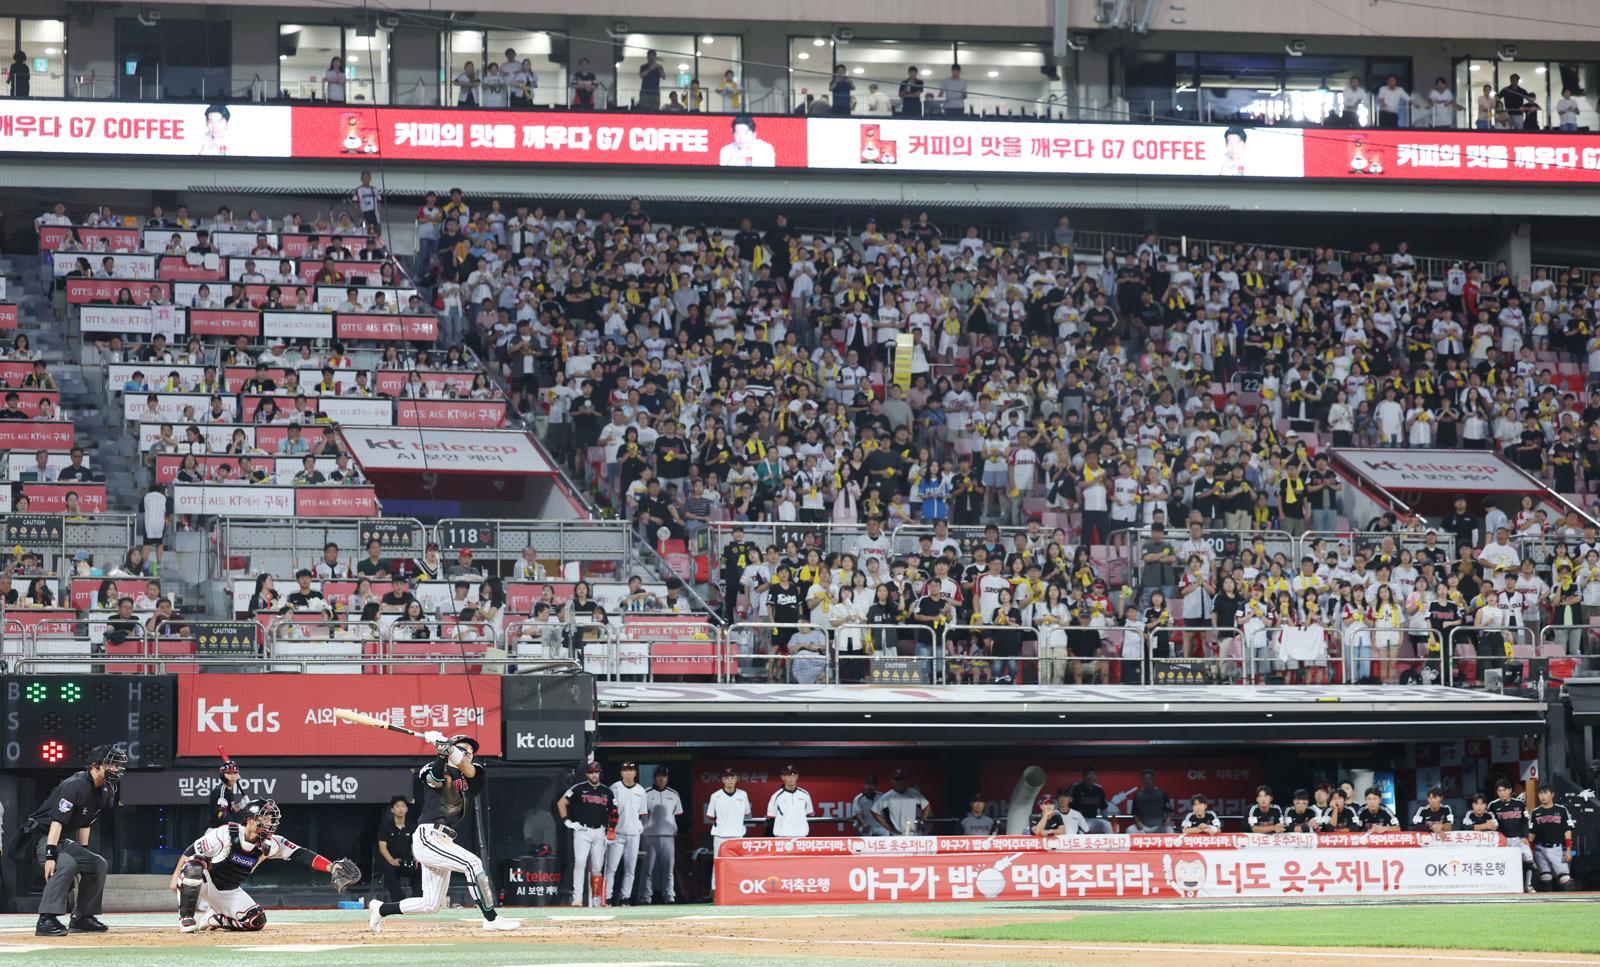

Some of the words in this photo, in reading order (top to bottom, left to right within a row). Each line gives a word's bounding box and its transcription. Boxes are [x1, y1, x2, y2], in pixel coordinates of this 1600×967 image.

[70, 116, 95, 138] G7
[104, 117, 184, 140] COFFEE
[394, 122, 463, 147] 커피의
[470, 124, 515, 148] 맛을
[522, 125, 591, 151] 깨우다
[596, 127, 623, 151] G7
[629, 128, 708, 153] COFFEE
[908, 135, 973, 157] 커피의
[981, 136, 1022, 158] 맛을
[1030, 137, 1095, 159] 깨우다
[1102, 139, 1125, 160] G7
[1133, 140, 1206, 161] COFFEE
[1397, 144, 1461, 168] 커피의
[1466, 145, 1508, 169] 맛을
[1513, 146, 1579, 170] 깨우다
[1244, 379, 1259, 391] 22
[365, 438, 405, 450] kt
[412, 441, 518, 455] telecop
[1363, 460, 1402, 470] kt
[1404, 462, 1499, 474] telecop
[263, 497, 288, 508] 구독!
[449, 528, 478, 543] 118
[736, 554, 747, 568] 4
[52, 624, 71, 633] 구독!
[212, 627, 237, 635] CAUTION
[8, 682, 20, 701] B
[128, 682, 142, 701] H
[7, 711, 20, 731] S
[128, 712, 140, 731] E
[197, 697, 239, 733] kt
[246, 703, 281, 733] ds
[304, 706, 338, 727] AI와
[452, 706, 485, 727] 곁에
[516, 732, 536, 749] kt
[537, 733, 575, 749] cloud
[6, 741, 21, 761] O
[742, 840, 772, 852] 야구가
[868, 842, 886, 851] 너도
[940, 838, 971, 850] 야구가
[1062, 838, 1081, 848] 너도
[1133, 836, 1162, 848] 야구가
[1251, 836, 1270, 847] 너도
[1320, 834, 1349, 846] 야구가
[230, 854, 258, 868] Kbank
[1461, 861, 1506, 876] 저축은행
[509, 867, 524, 883] kt
[848, 865, 940, 901] 야구가
[947, 864, 978, 899] 밥
[1011, 862, 1160, 898] 먹여주더라.
[1215, 862, 1271, 894] 너도
[1279, 859, 1405, 893] 읏수저니?
[516, 886, 526, 896] AI
[527, 886, 545, 896] 보안
[780, 877, 830, 893] 저축은행
